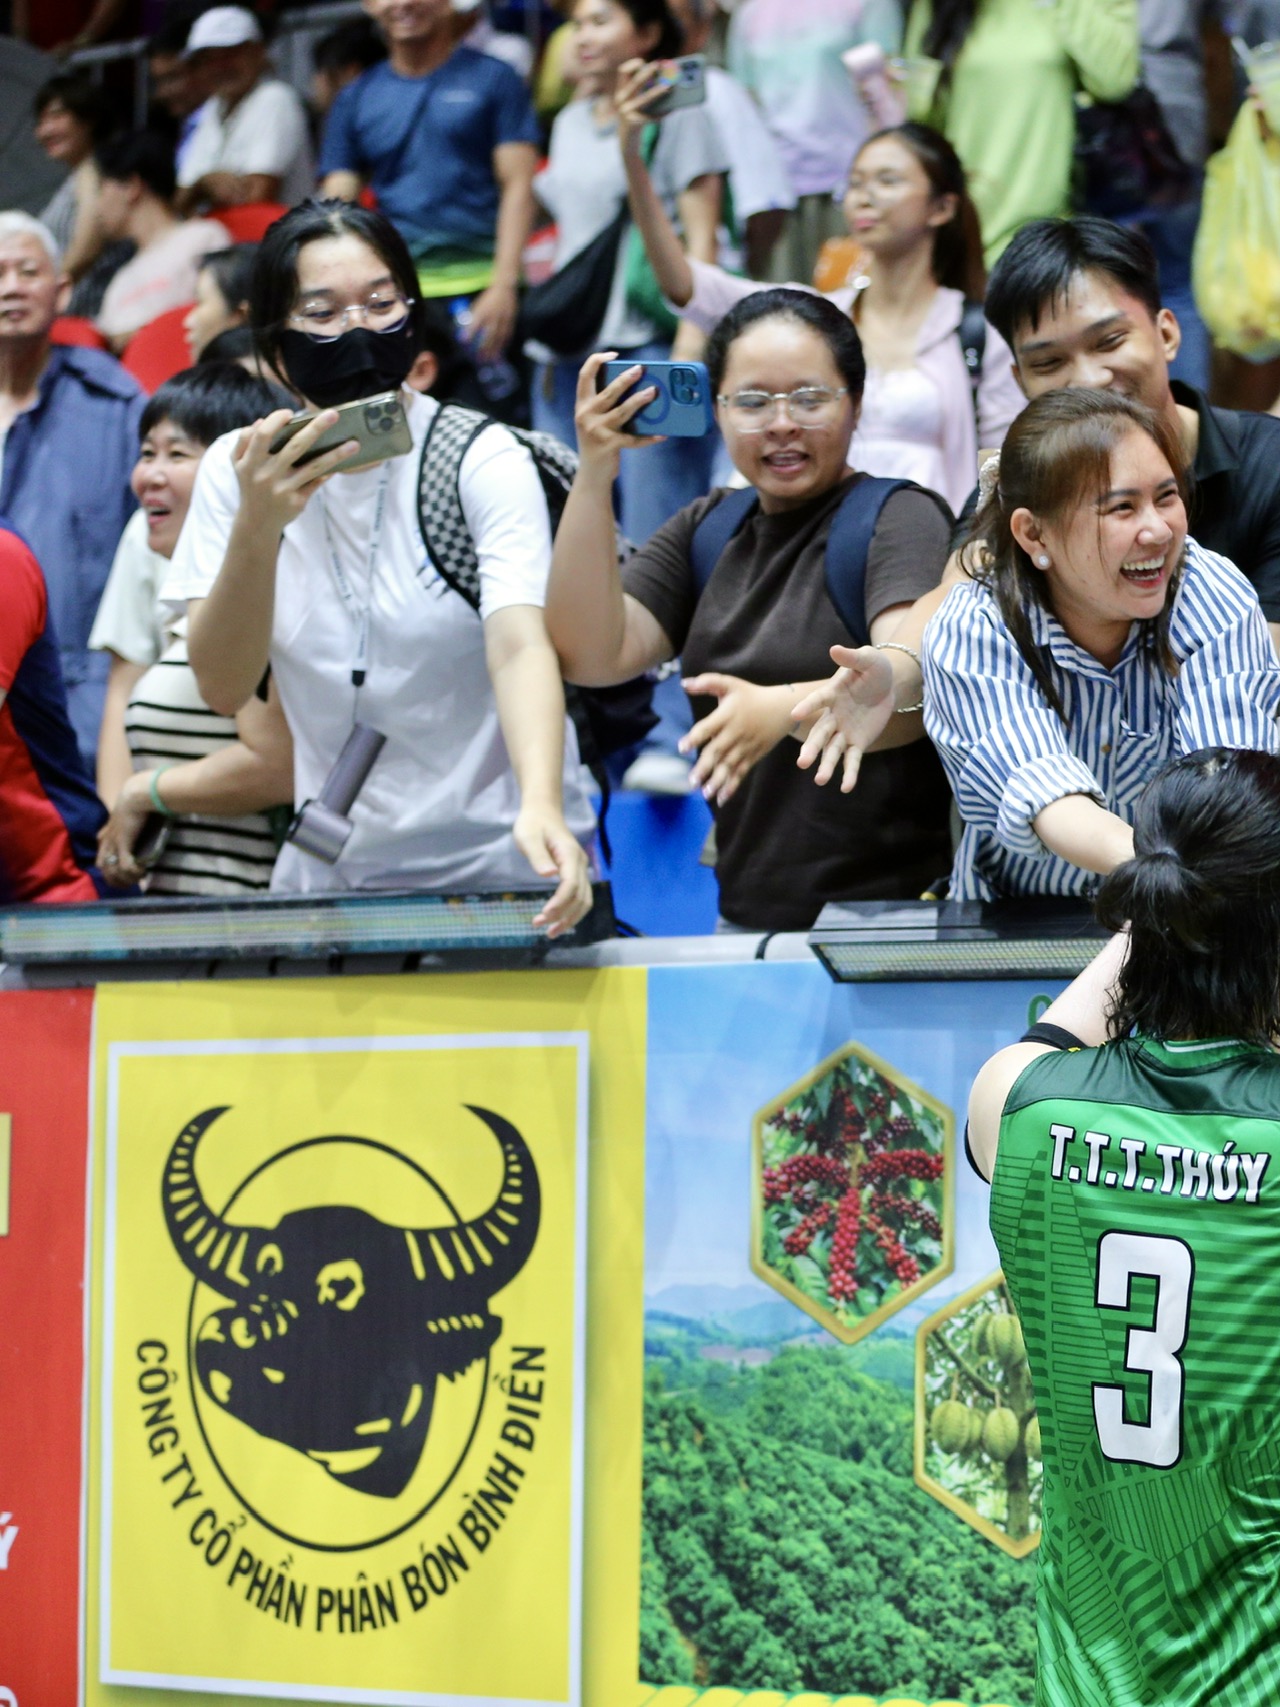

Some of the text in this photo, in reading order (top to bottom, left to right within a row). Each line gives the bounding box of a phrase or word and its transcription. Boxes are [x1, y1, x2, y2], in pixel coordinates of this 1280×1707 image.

[1050, 1123, 1272, 1204] T.T.T.THÚY
[1091, 1227, 1195, 1471] 3
[136, 1338, 180, 1458] CÔNG
[161, 1452, 203, 1510] TY
[189, 1507, 248, 1567] CỔ
[316, 1570, 399, 1634] PHÂN
[401, 1534, 470, 1613] BÓN
[458, 1451, 526, 1554] BÌNH
[492, 1345, 546, 1452] ĐIỀN
